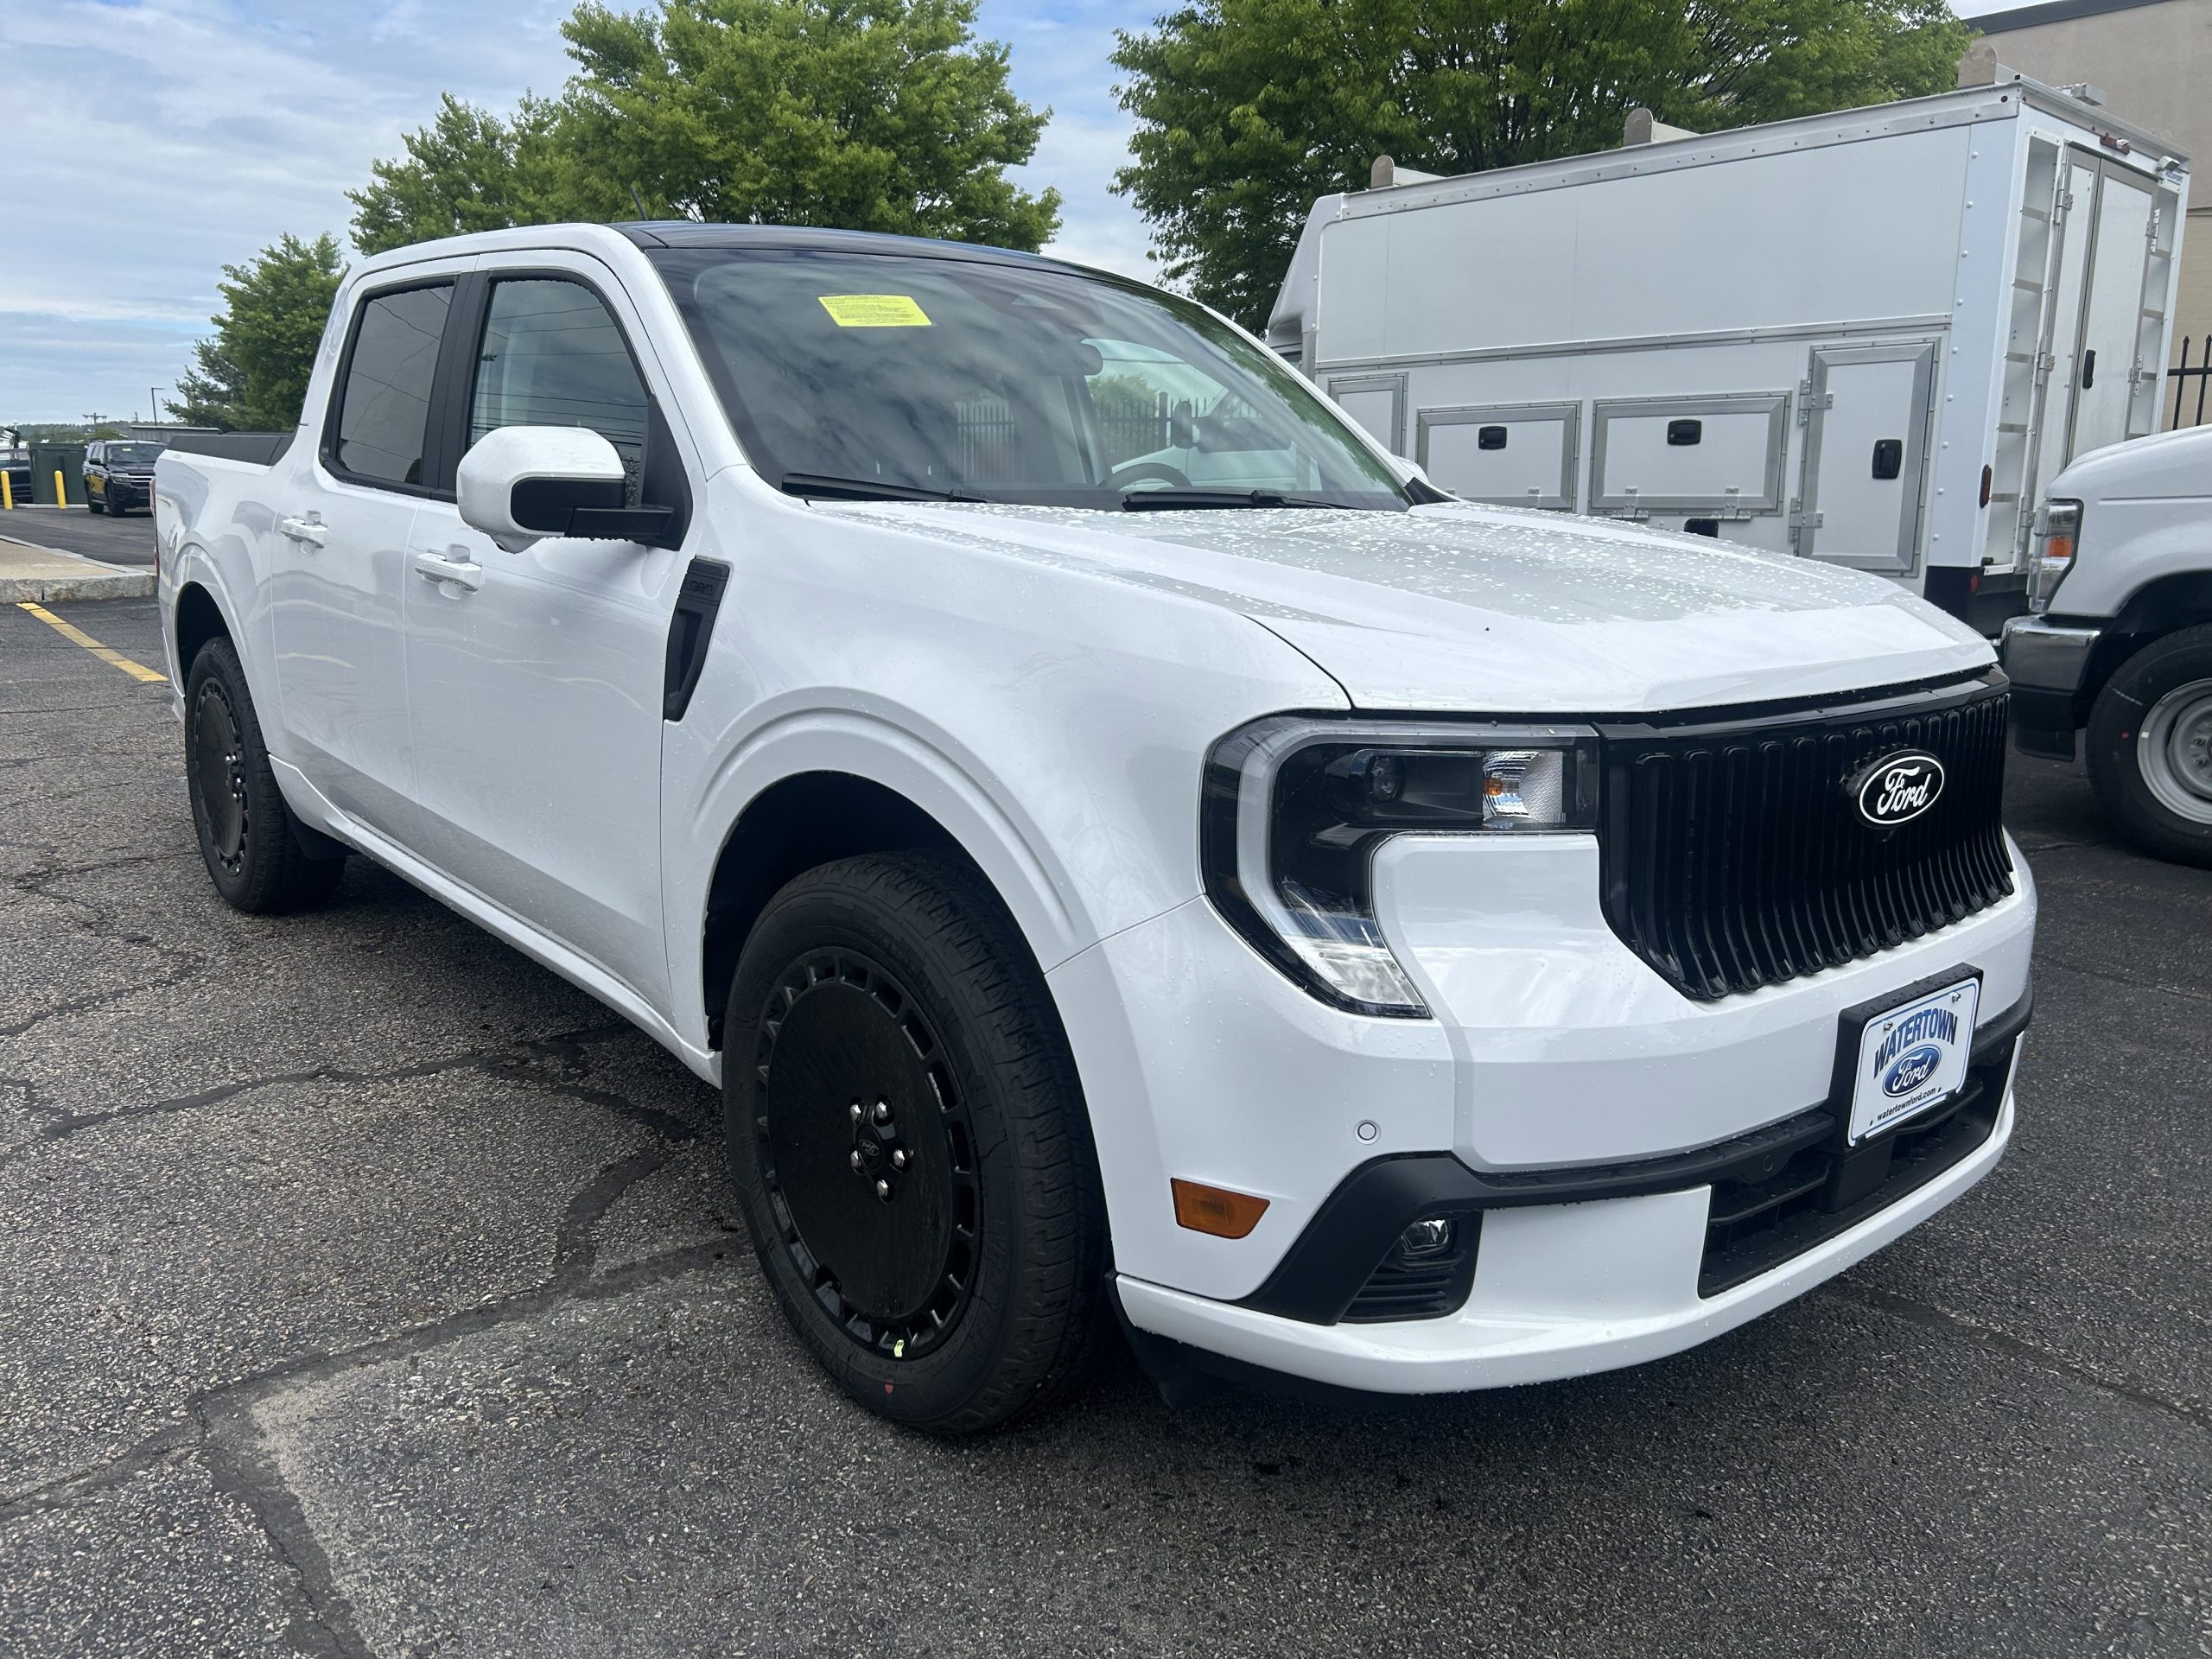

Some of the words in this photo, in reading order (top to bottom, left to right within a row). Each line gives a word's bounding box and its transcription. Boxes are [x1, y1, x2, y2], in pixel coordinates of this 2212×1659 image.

[1877, 766, 1931, 816] Ford
[1873, 1007, 1958, 1079] WATERTOWN
[1892, 1052, 1933, 1091] Ford
[1877, 1087, 1936, 1122] watertownford.com
